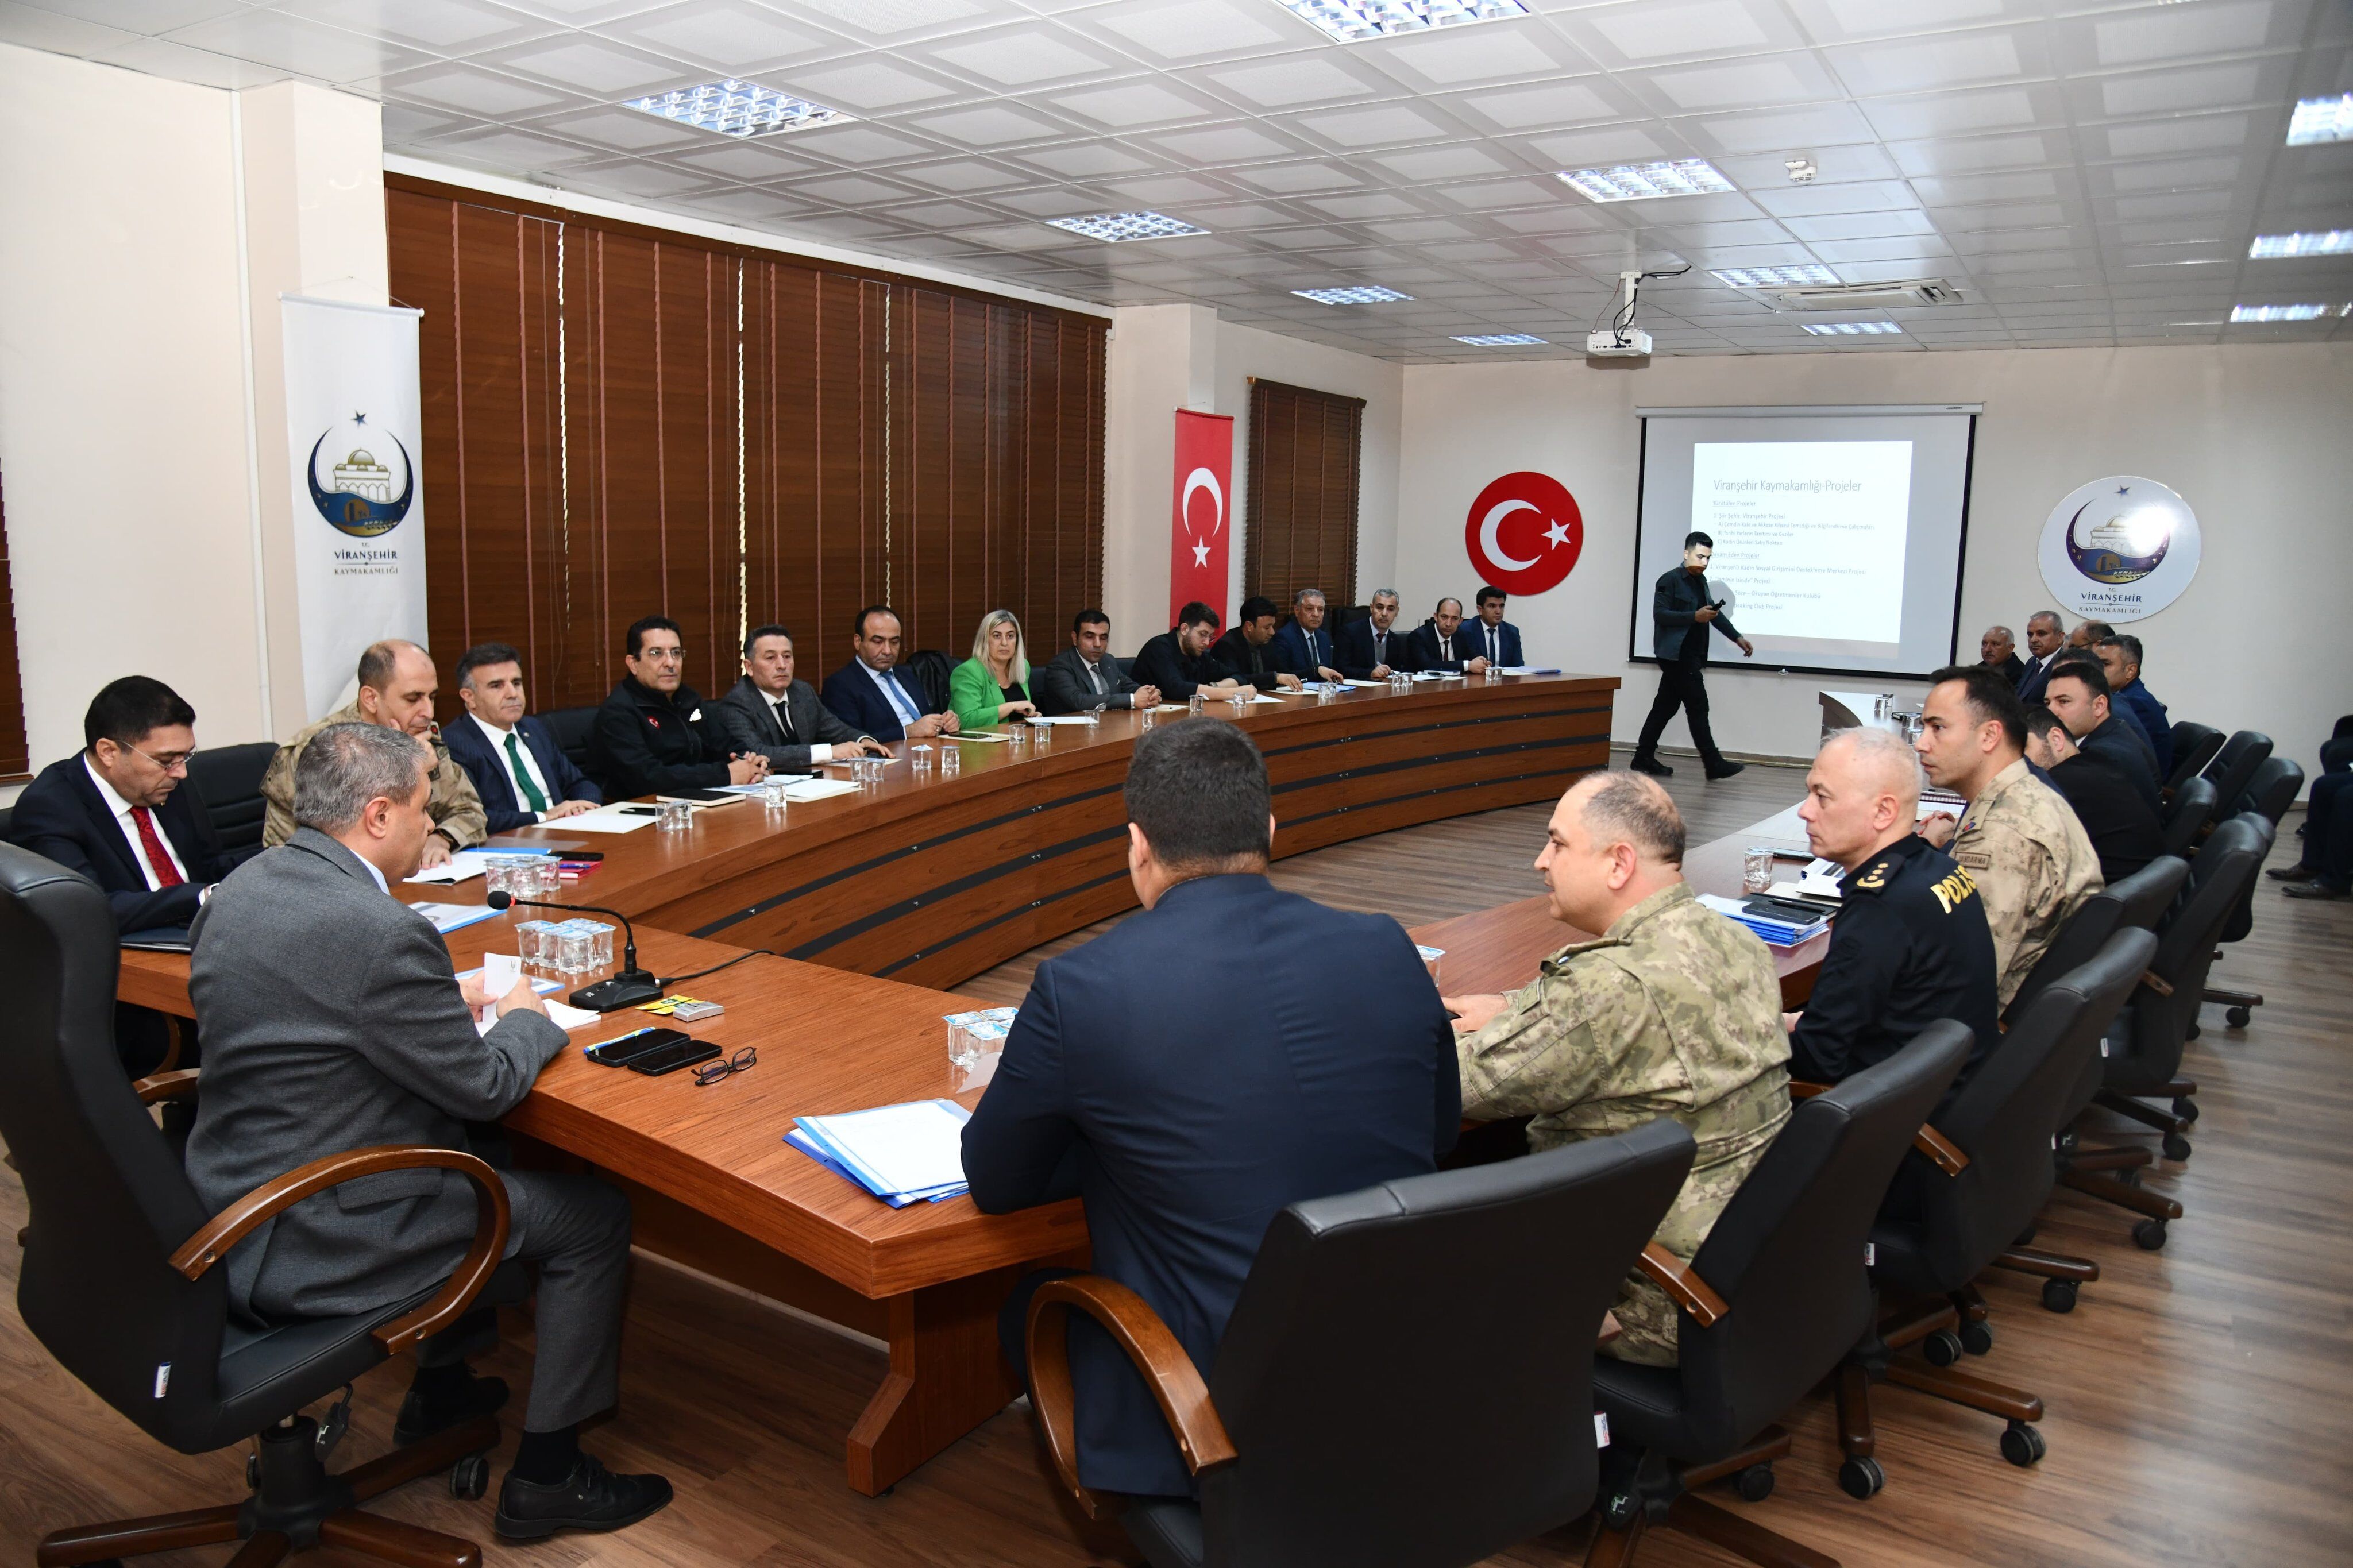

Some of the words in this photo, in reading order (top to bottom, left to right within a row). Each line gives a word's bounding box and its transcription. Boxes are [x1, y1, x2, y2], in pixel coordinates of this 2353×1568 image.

[1714, 479, 1758, 493] Viranşehir
[1760, 479, 1862, 494] Kaymakamlığı-Projeler
[334, 549, 398, 561] VİRANŞEHİR
[334, 566, 398, 575] KAYMAKAMLIĞI
[2081, 592, 2142, 603] VİRANŞEHİR
[2079, 606, 2141, 614] KAYMAKAMLIĞI
